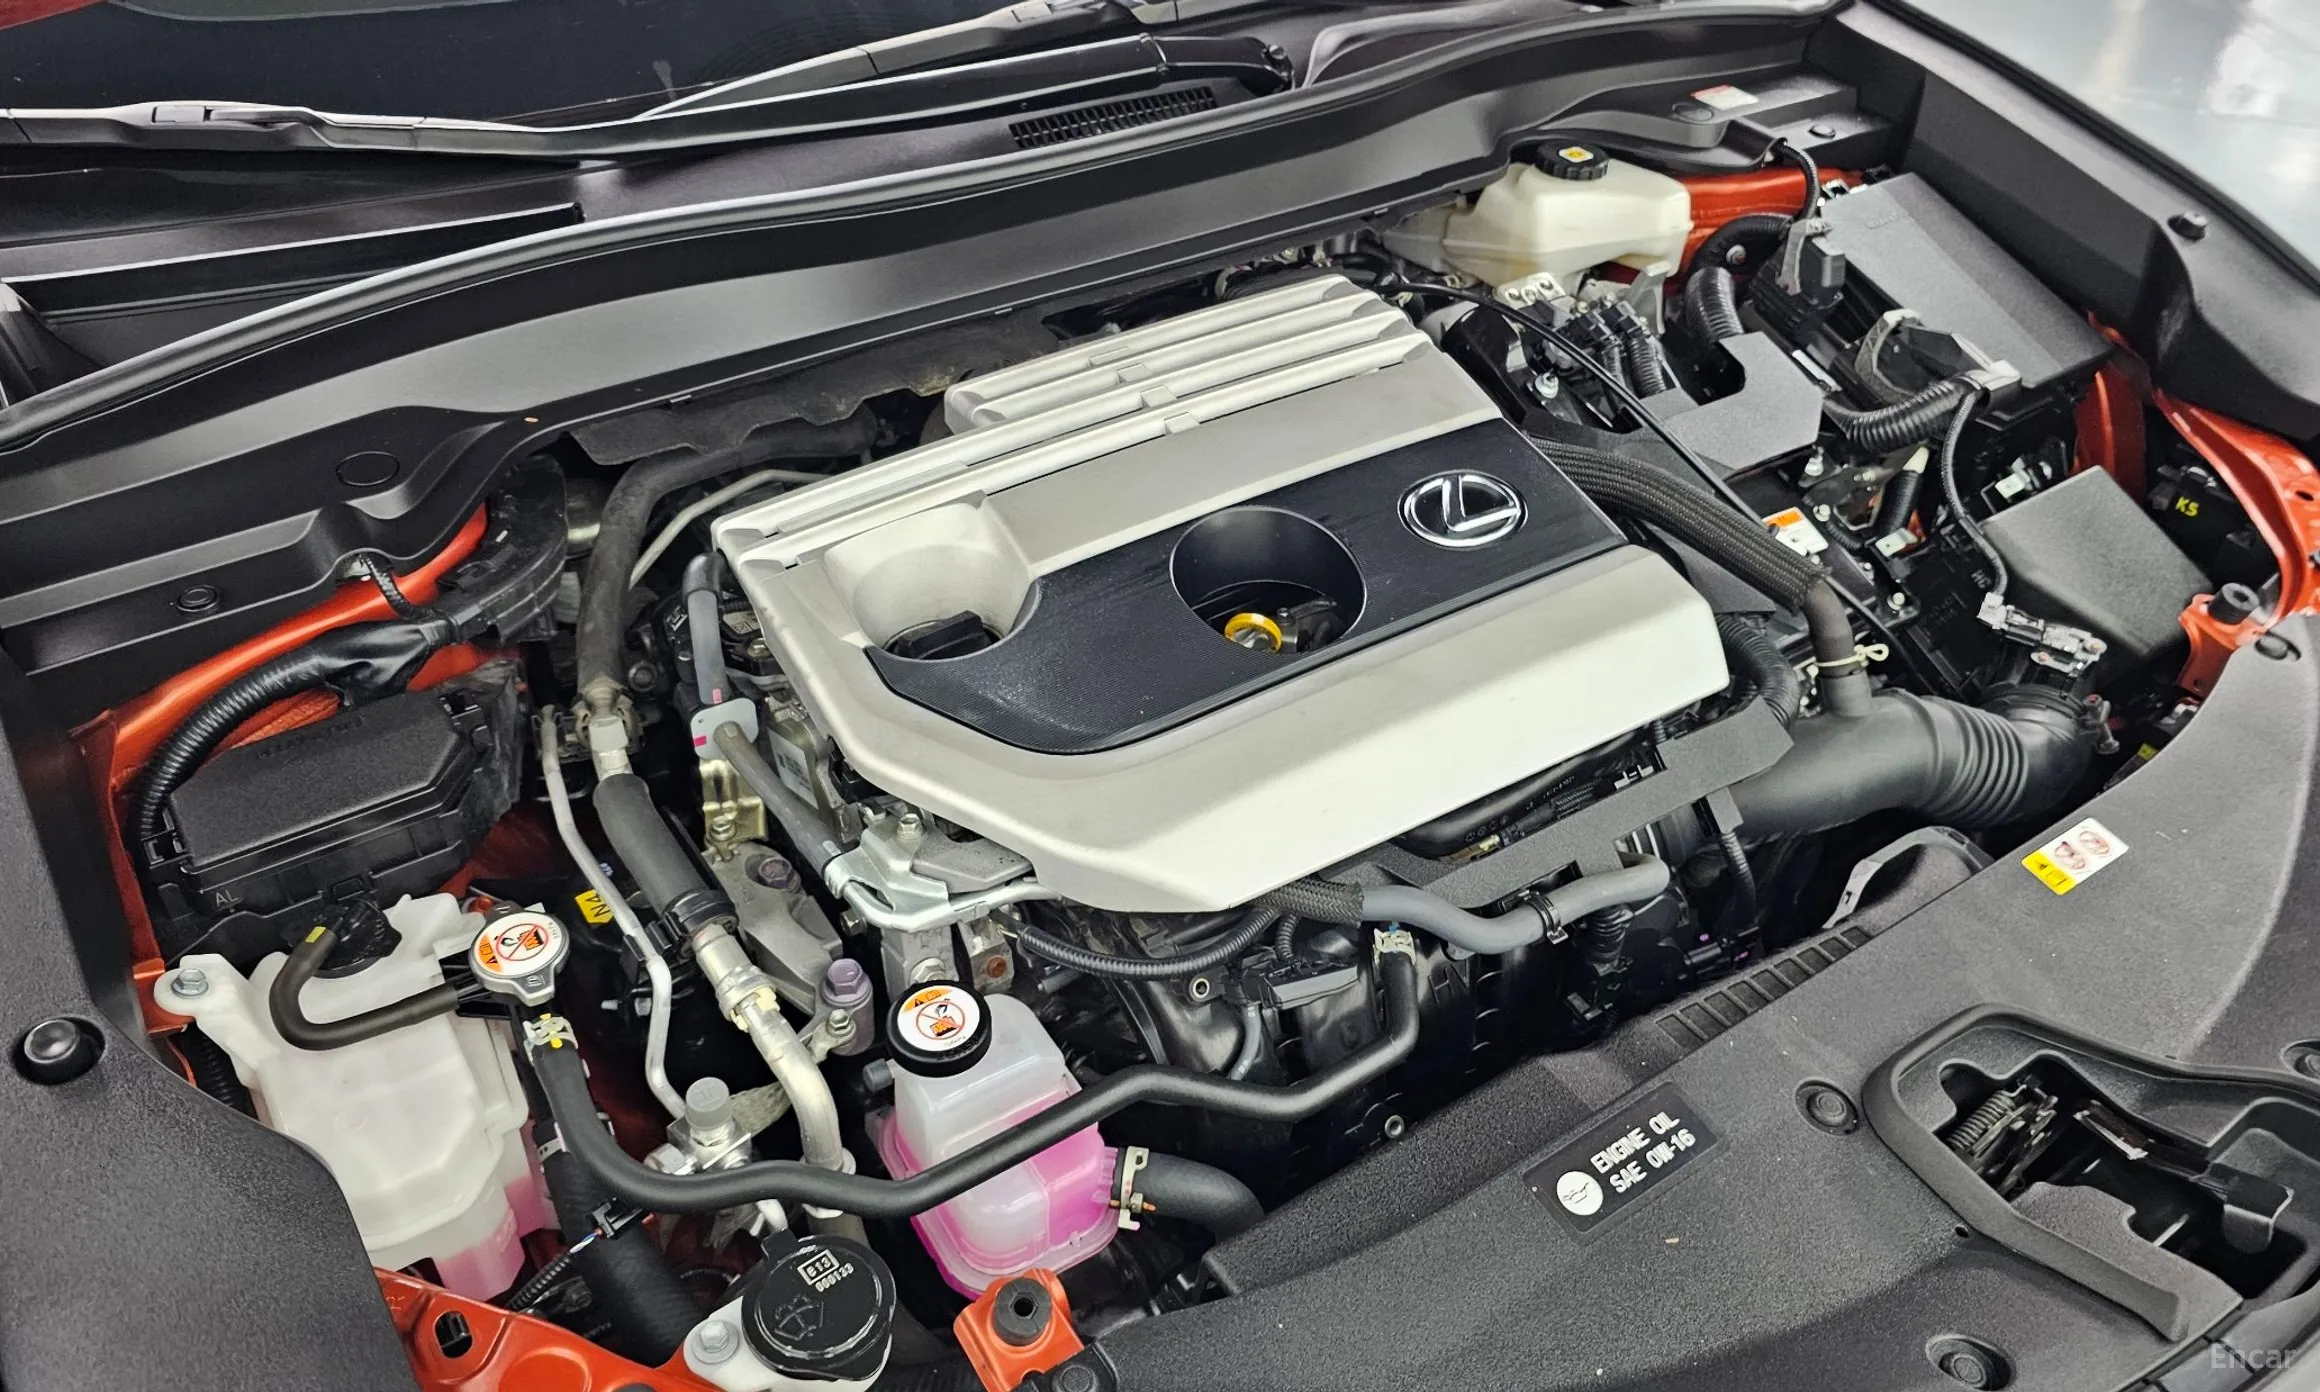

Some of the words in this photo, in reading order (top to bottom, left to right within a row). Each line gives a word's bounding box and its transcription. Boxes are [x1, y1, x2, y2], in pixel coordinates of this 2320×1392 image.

[1590, 1127, 1651, 1174] ENGINE
[1649, 1111, 1680, 1135] OIL
[1609, 1160, 1647, 1193] SAE
